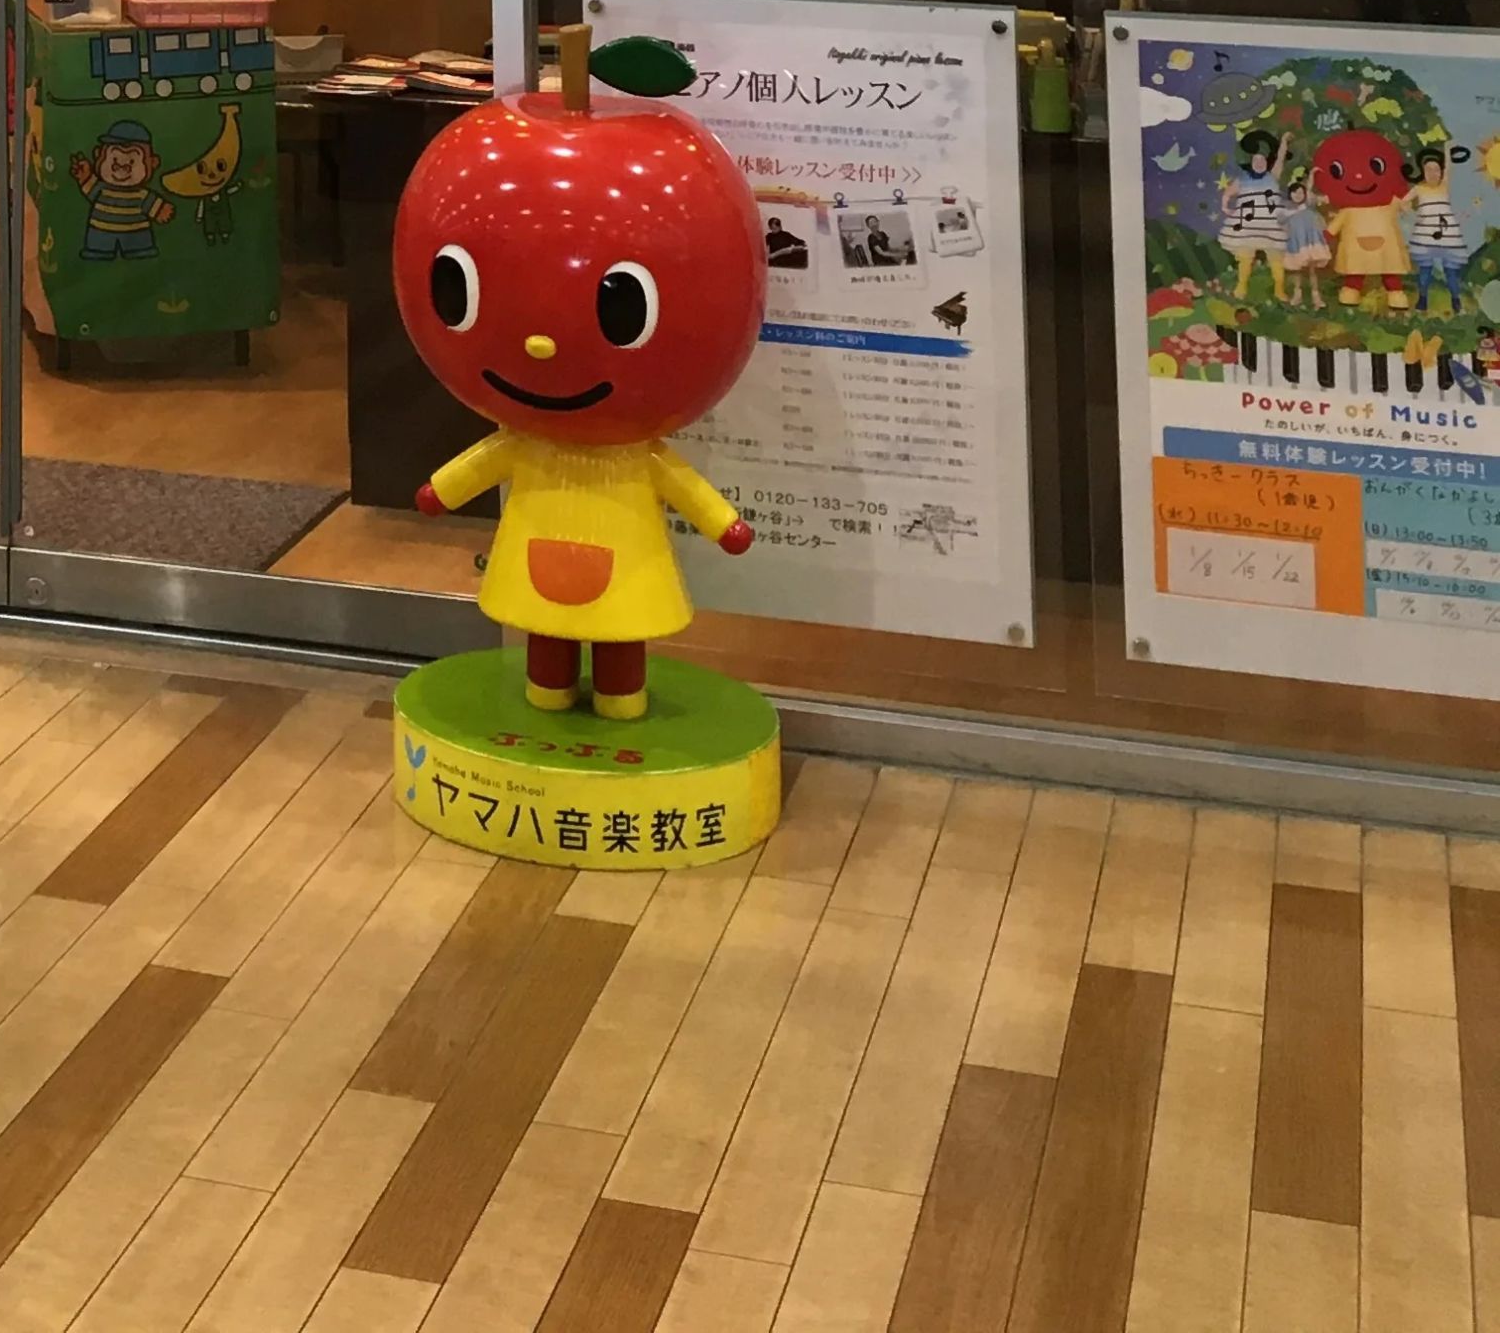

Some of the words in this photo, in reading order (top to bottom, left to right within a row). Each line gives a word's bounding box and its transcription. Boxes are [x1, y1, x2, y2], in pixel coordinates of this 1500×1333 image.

[1242, 391, 1331, 416] Power
[1345, 402, 1373, 419] of
[1391, 405, 1477, 429] Music
[1238, 440, 1486, 480] 無料体験レッスン受付中！
[754, 493, 888, 516] 0120-133-705
[751, 532, 837, 549] ヶ谷センター
[488, 732, 644, 765] ぷっぷる
[506, 780, 546, 798] School
[432, 772, 727, 854] ヤマハ音楽教室
